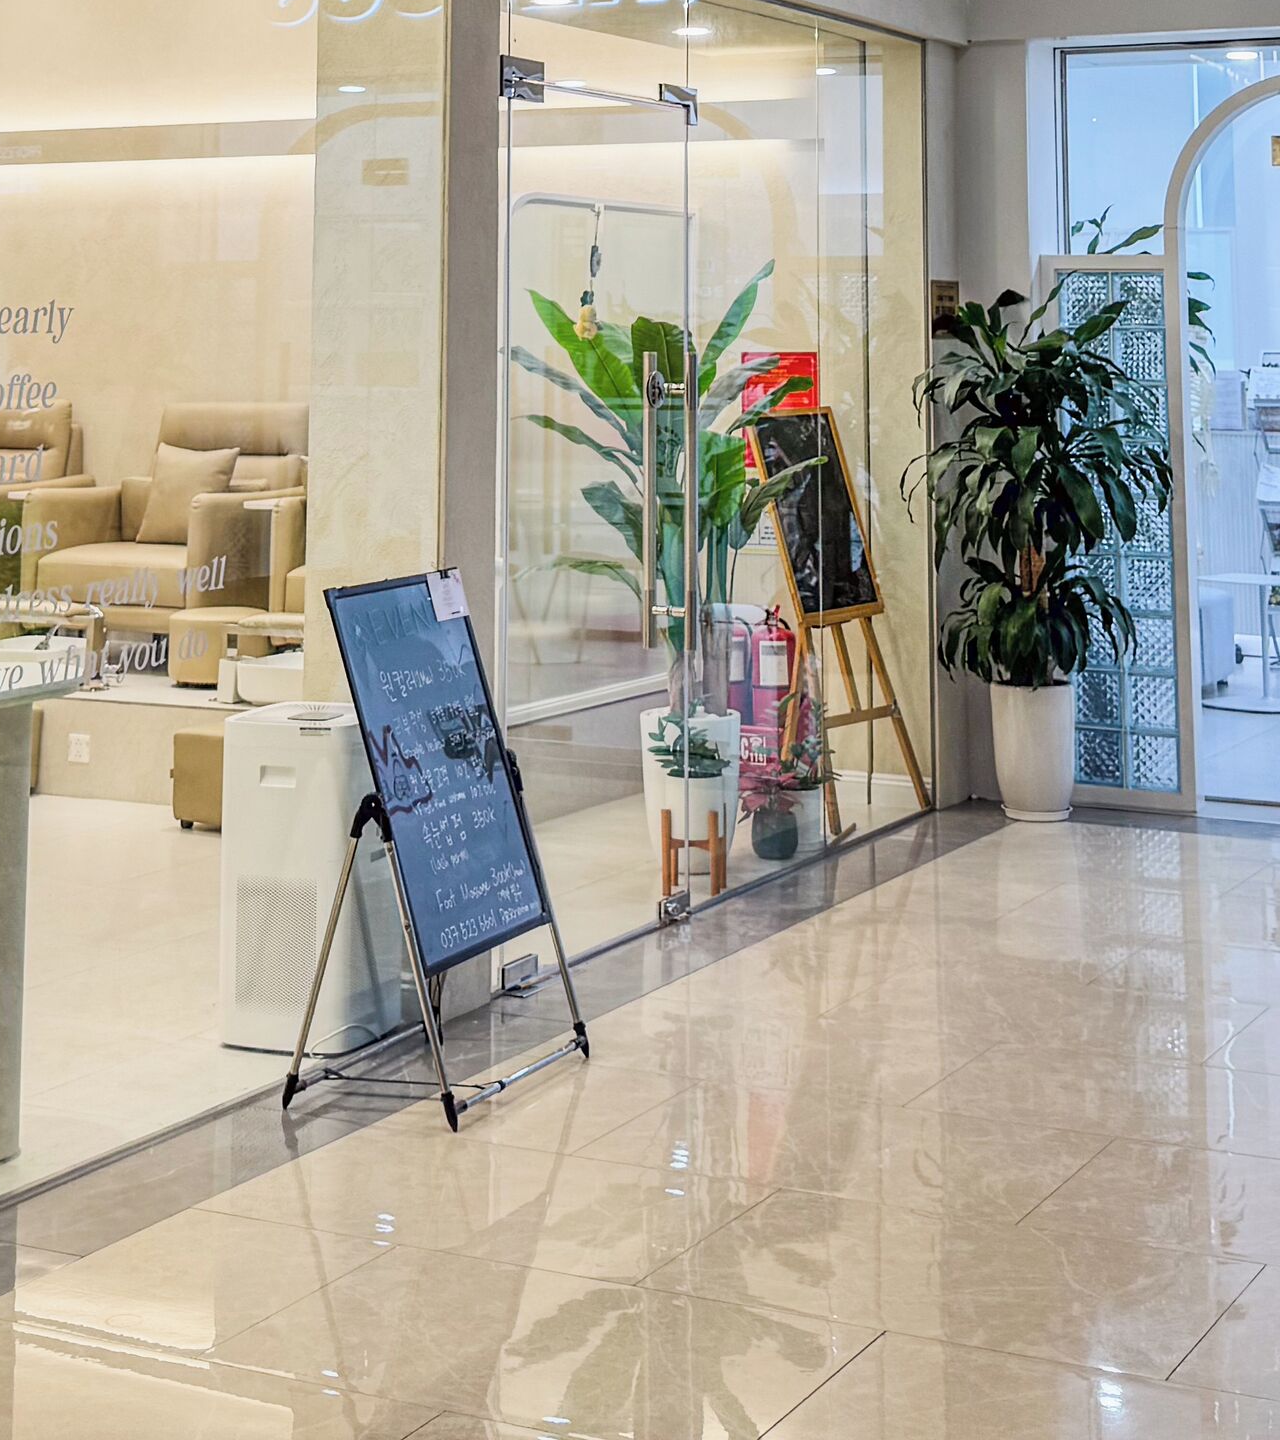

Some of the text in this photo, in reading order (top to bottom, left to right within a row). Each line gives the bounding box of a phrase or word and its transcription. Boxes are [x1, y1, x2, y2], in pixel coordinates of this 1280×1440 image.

[84, 566, 160, 609] really
[176, 553, 227, 596] well
[111, 636, 168, 685] you
[178, 624, 209, 661] do
[435, 888, 456, 913] Foot
[440, 924, 460, 950] 037
[459, 917, 478, 942] 523
